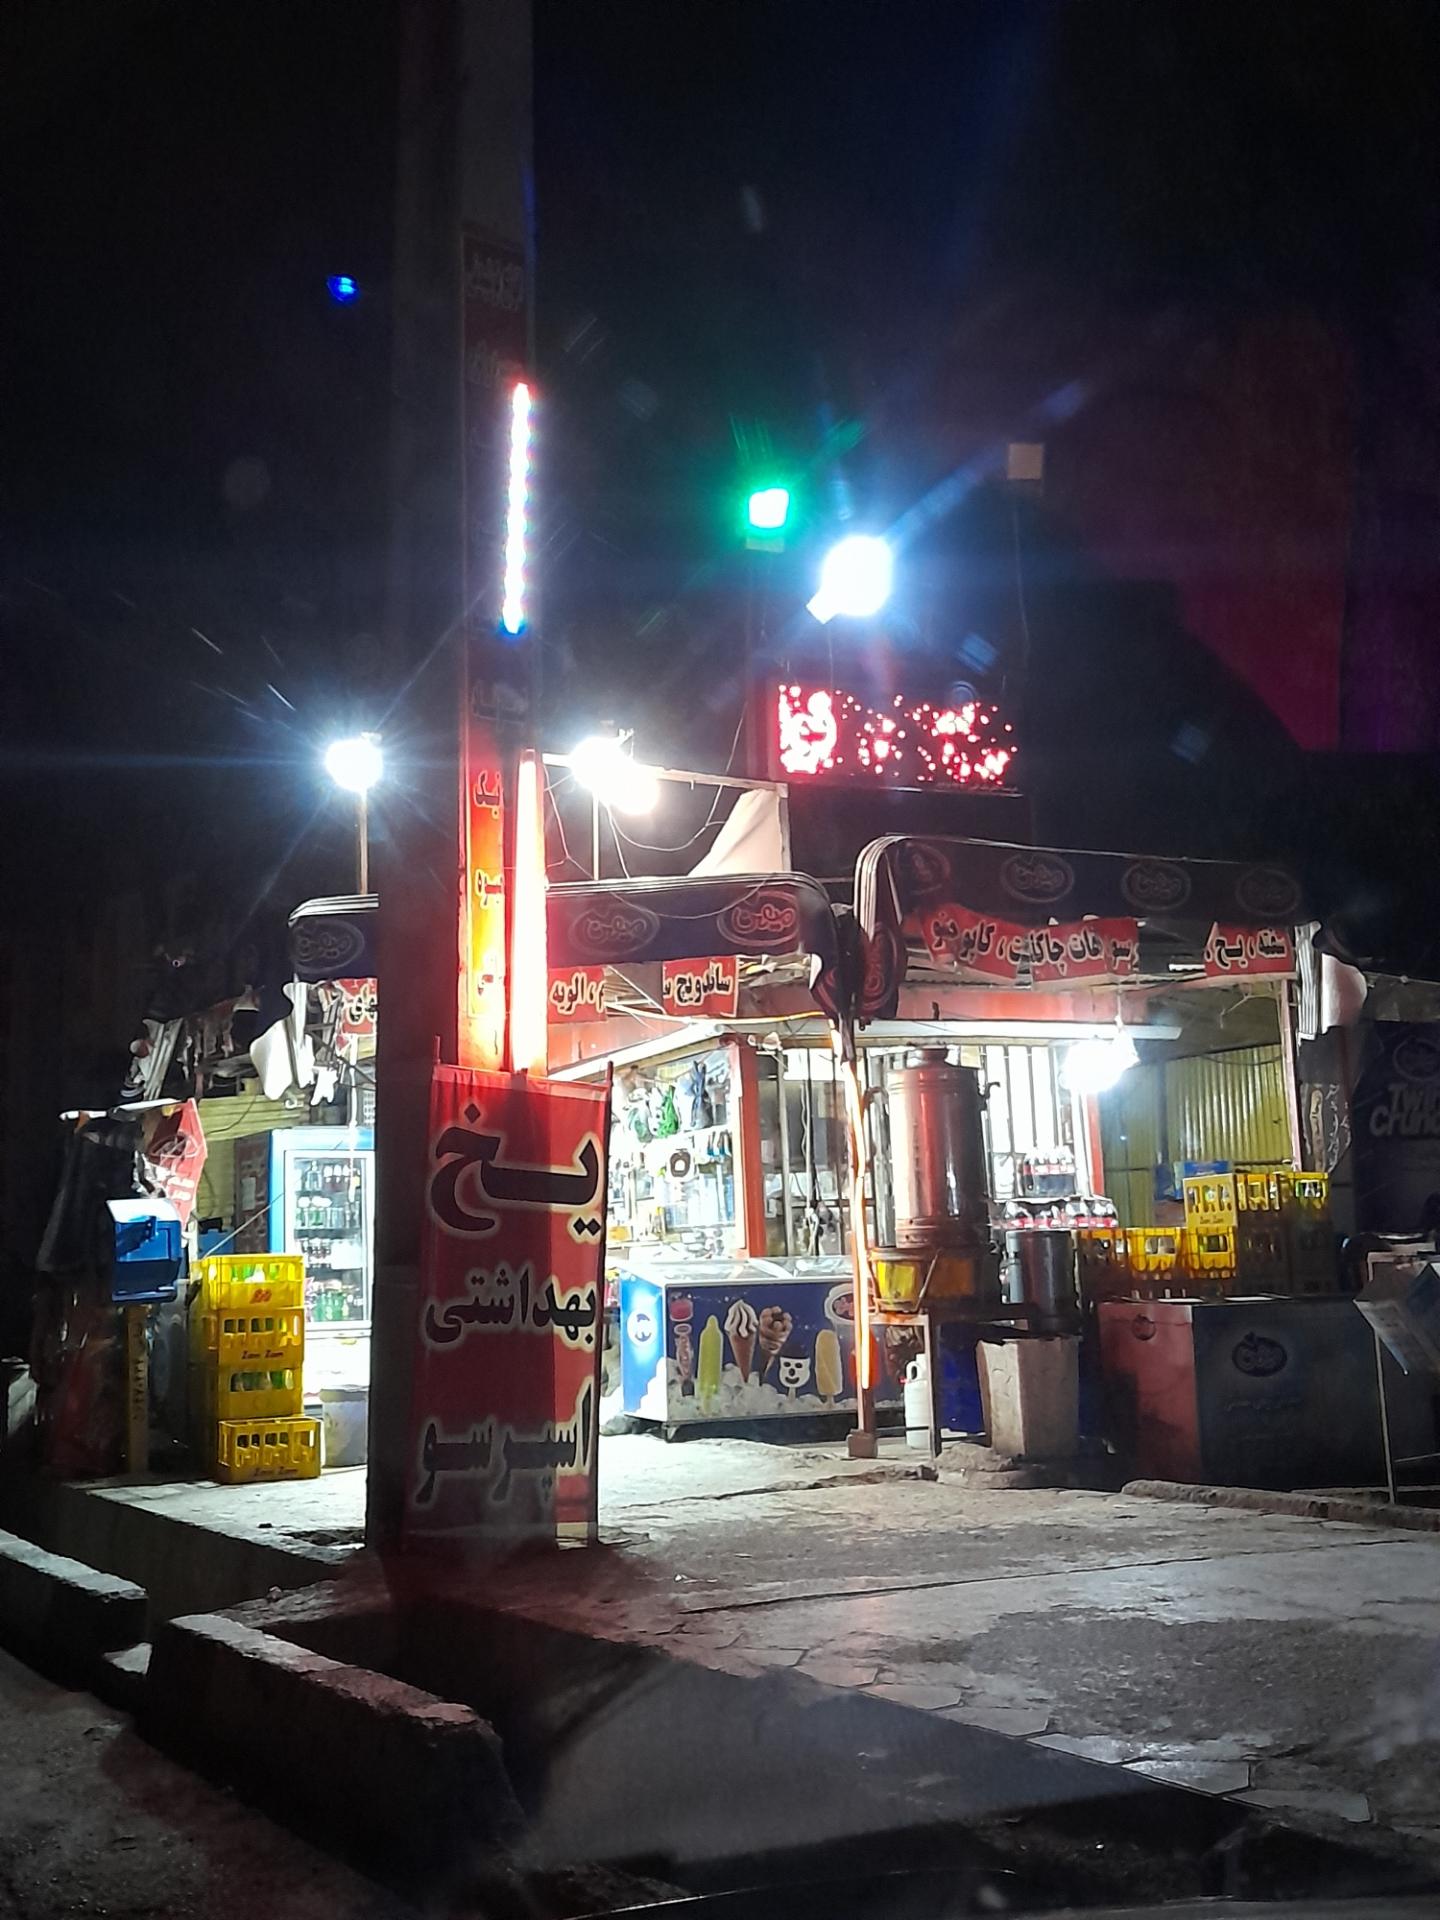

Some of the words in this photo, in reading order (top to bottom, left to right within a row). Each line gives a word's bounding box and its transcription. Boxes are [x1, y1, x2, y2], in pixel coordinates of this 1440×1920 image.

[732, 903, 796, 934] میهن
[677, 965, 730, 1003] ساندویچ
[430, 1102, 602, 1236] یخ
[424, 1267, 598, 1344] بهداشتی
[417, 1382, 592, 1504] اسپرسو
